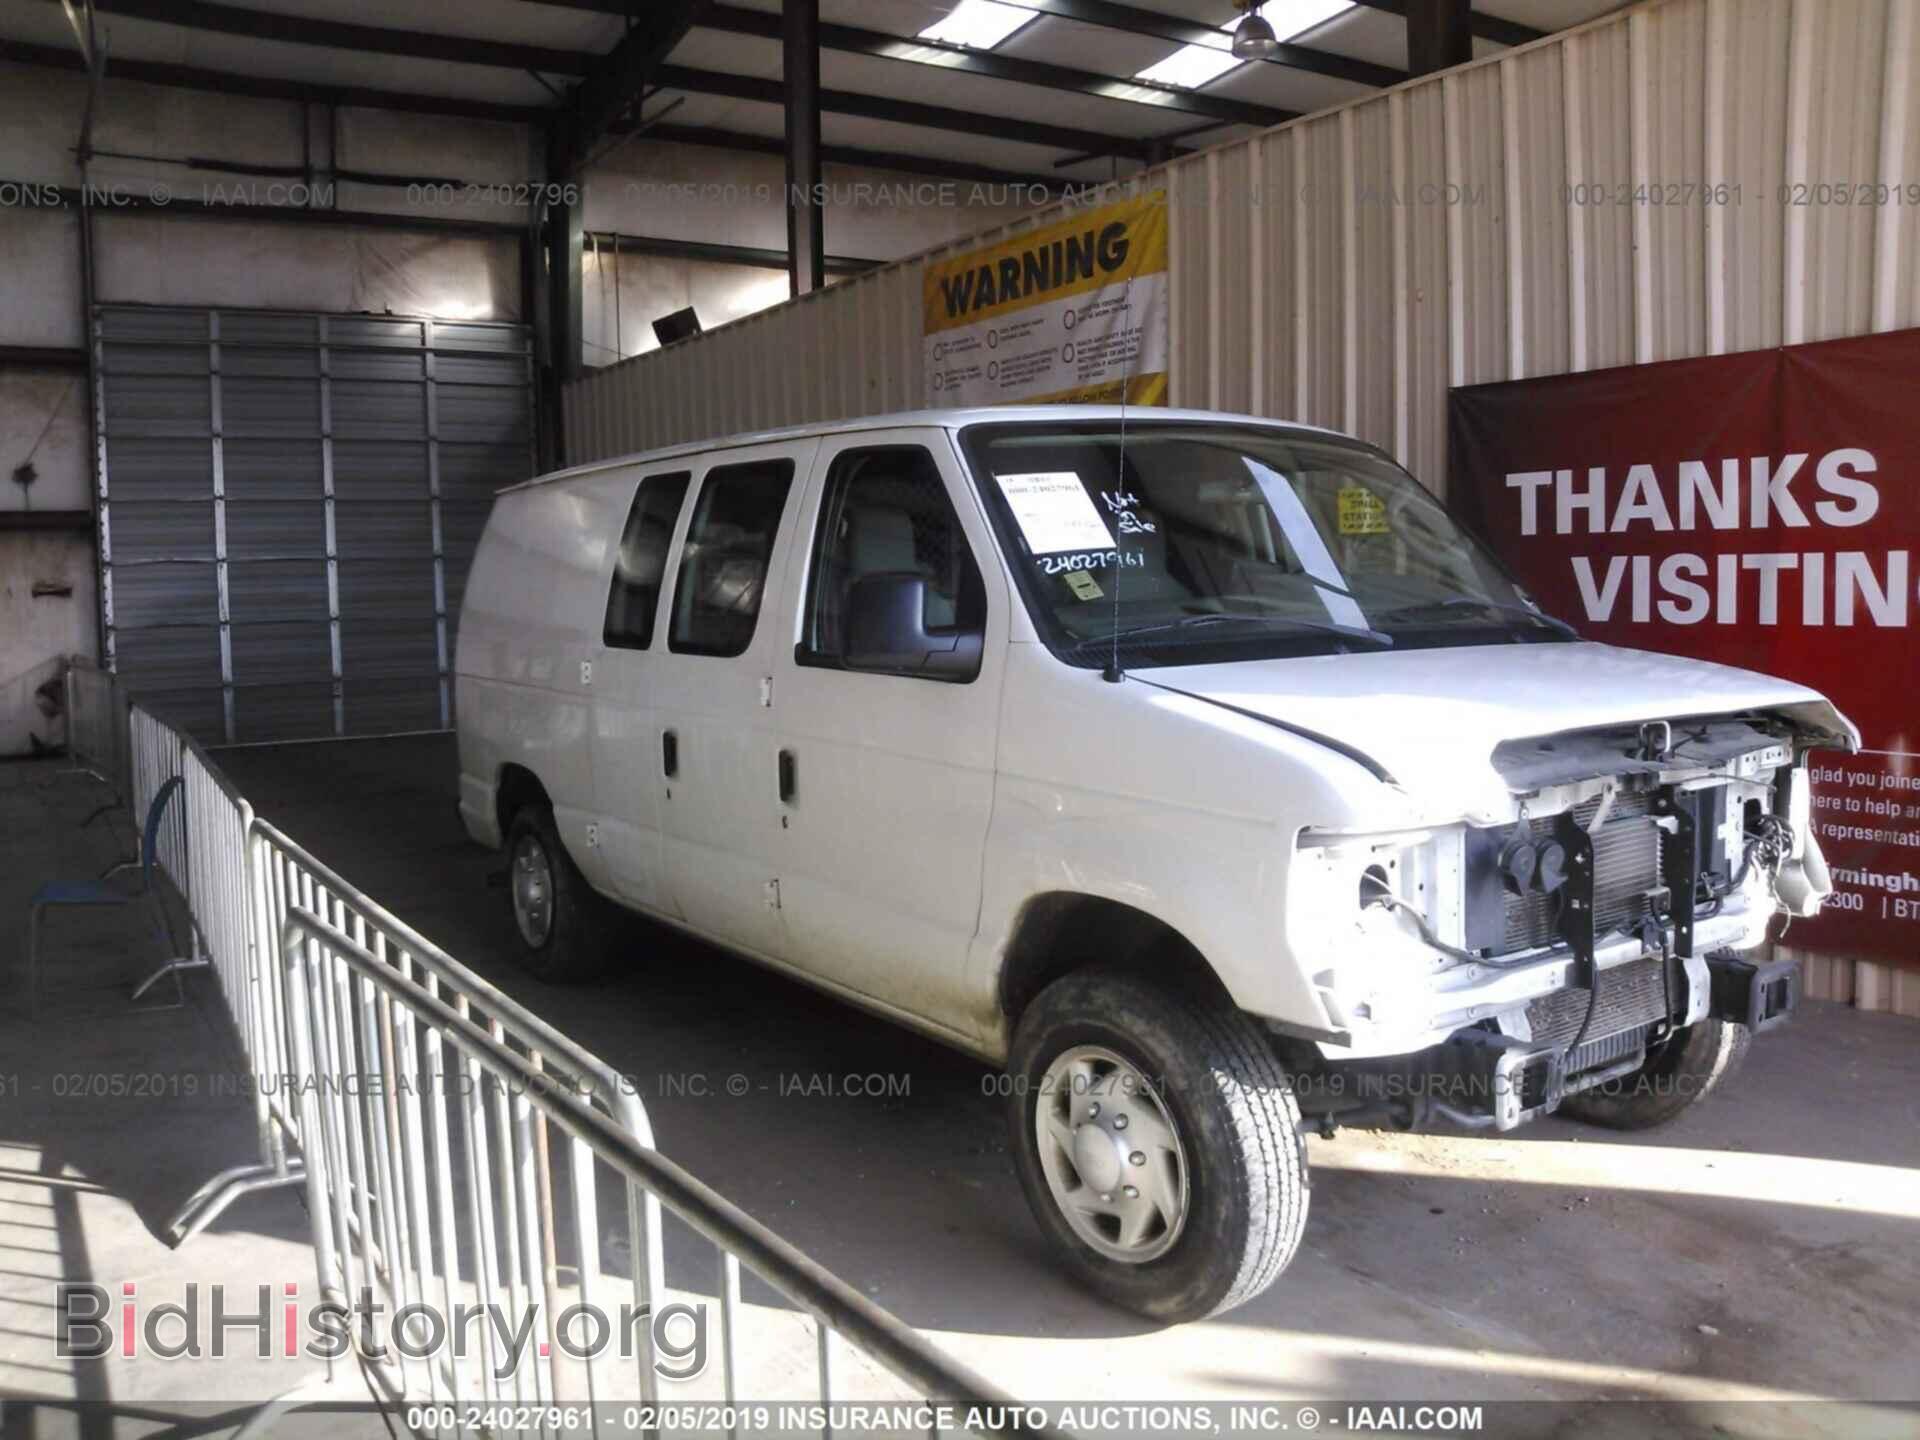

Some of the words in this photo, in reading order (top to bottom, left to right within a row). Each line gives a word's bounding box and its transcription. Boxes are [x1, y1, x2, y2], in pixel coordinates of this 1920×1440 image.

[940, 220, 1130, 319] WARNING
[1505, 447, 1880, 537] THANKS
[1570, 549, 1920, 628] VISITIN
[1810, 765, 1843, 784] glad
[1847, 771, 1876, 788] you
[1845, 796, 1860, 813] to
[1864, 796, 1901, 819] help
[1822, 823, 1920, 847] representati
[1825, 862, 1920, 893] rmingh
